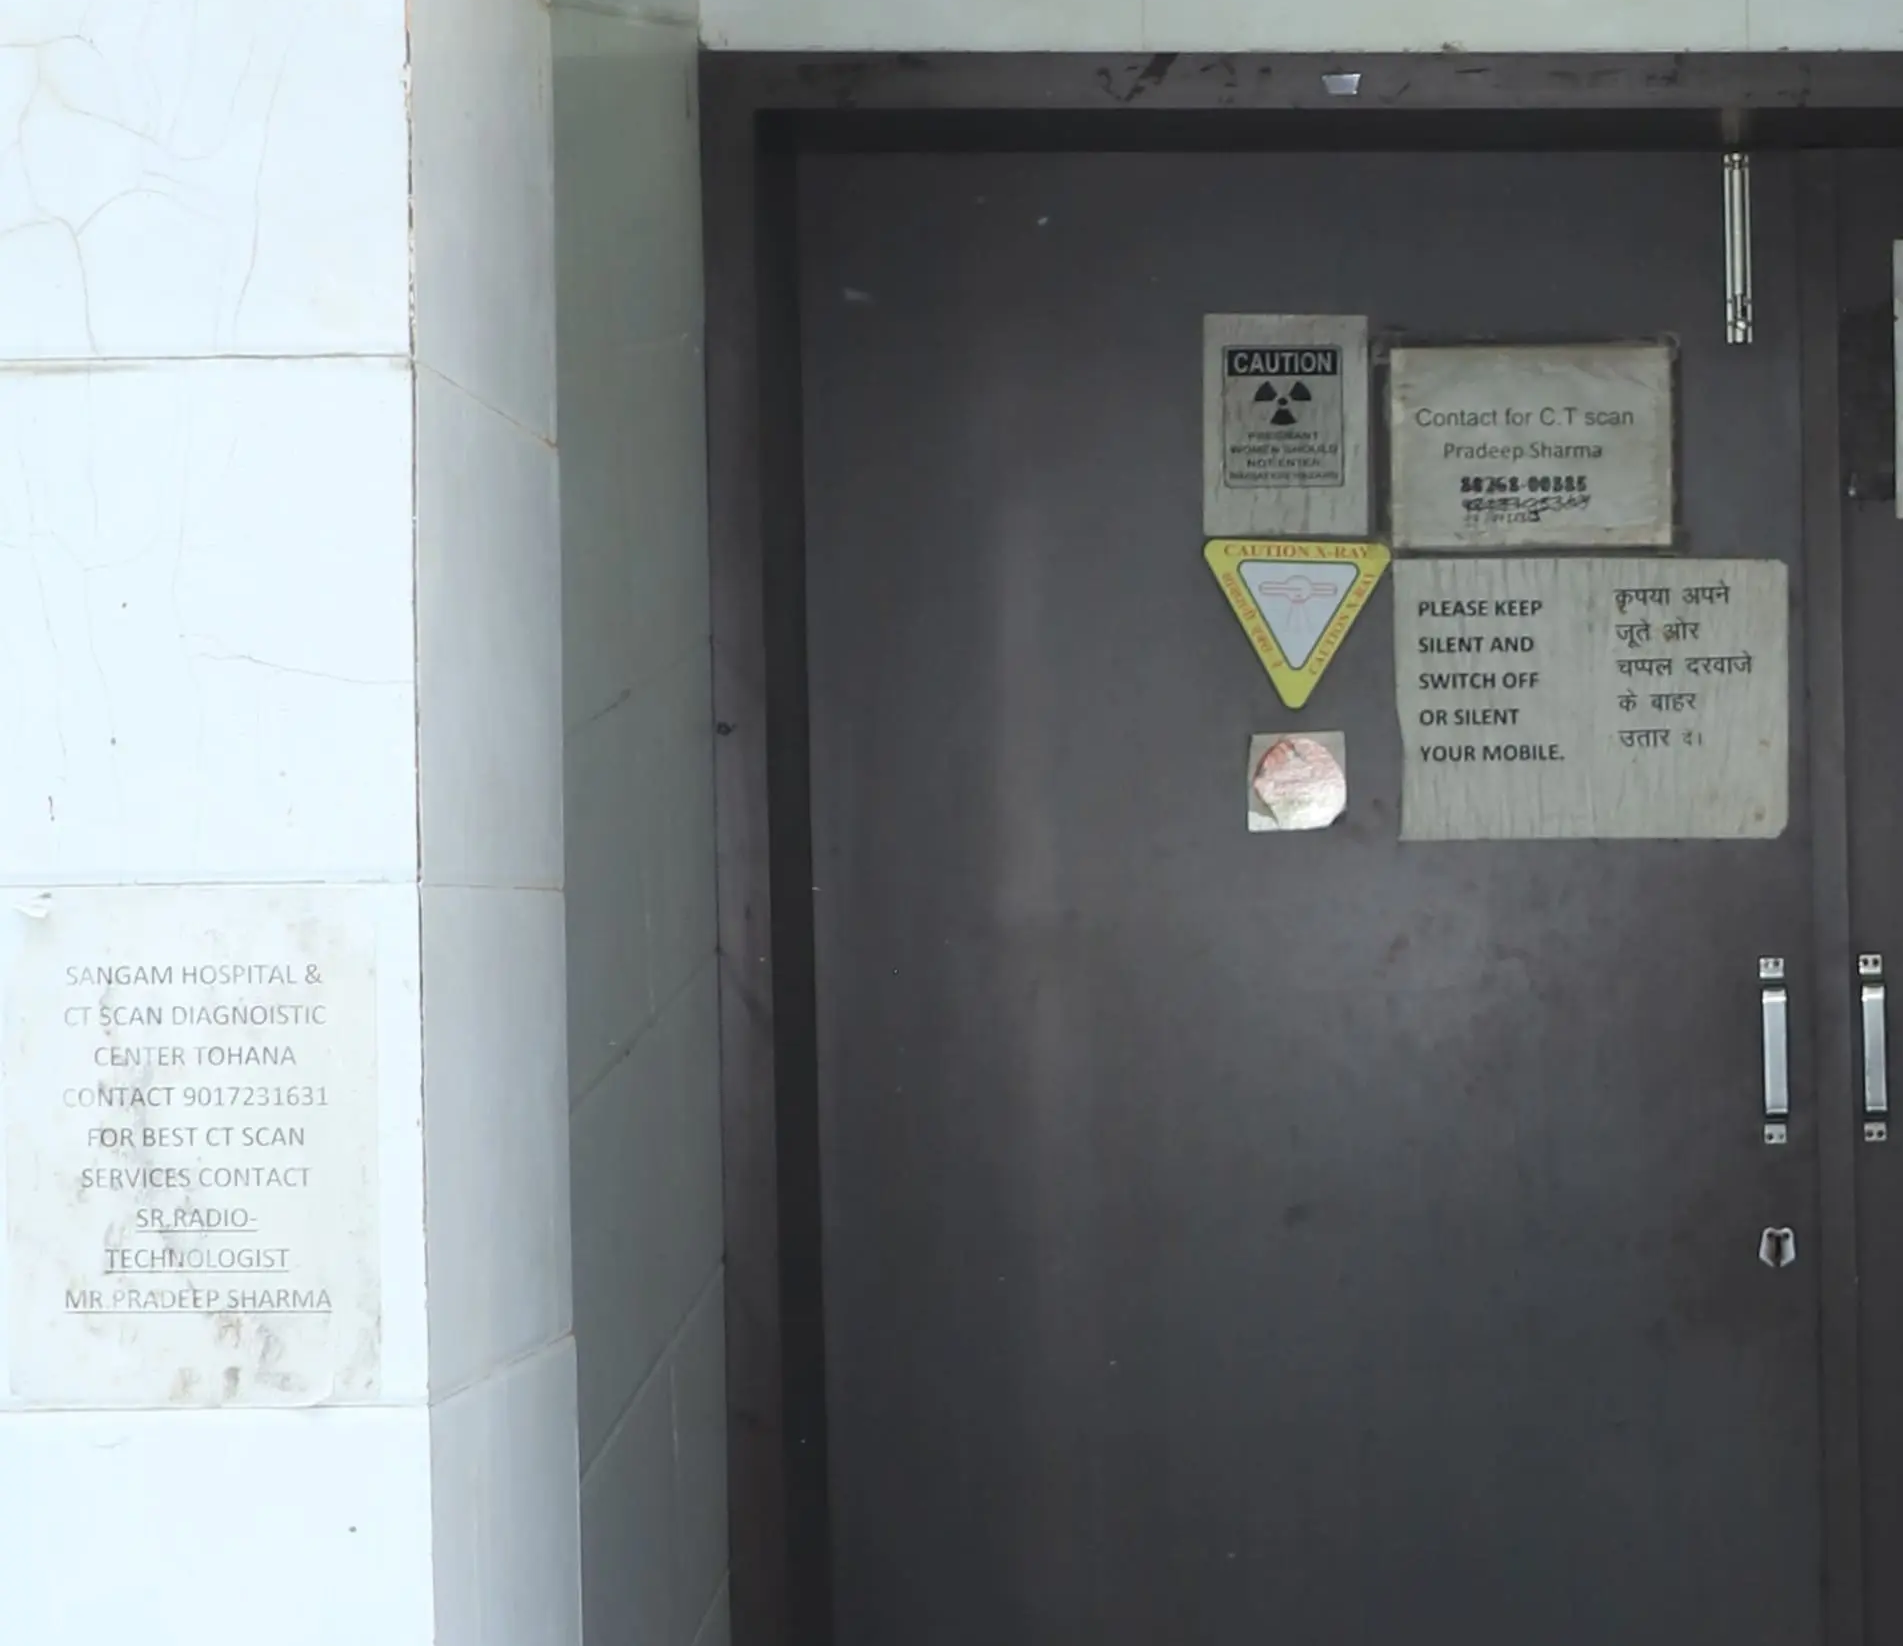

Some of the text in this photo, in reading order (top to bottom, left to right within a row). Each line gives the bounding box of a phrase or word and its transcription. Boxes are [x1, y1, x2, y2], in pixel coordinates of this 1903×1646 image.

[1234, 351, 1332, 373] CAUTION
[1415, 407, 1634, 427] Contact for C.T scan
[1444, 442, 1603, 462] Pradeep Sharma
[1224, 544, 1370, 560] CAUTION X-RAY
[1614, 579, 1731, 614] कृपया अपने
[1418, 600, 1543, 617] PLEASE KEEP
[1615, 618, 1652, 649] जूते
[1418, 637, 1534, 653] SILENT AND
[1616, 649, 1754, 676] चप्पल दरवाजे
[1419, 672, 1540, 690] SWITCH OFF
[1617, 687, 1638, 712] के
[1419, 709, 1520, 726] OR SILENT
[1617, 728, 1671, 747] उतार
[1420, 744, 1566, 762] YOUR MOBILE.
[66, 964, 323, 986] SANGAM HOSPITAL &
[63, 1006, 91, 1027] CT
[99, 1005, 163, 1027] SCAN
[94, 1045, 297, 1067] CENTER TOHANA
[62, 1086, 329, 1109] CONTACT 9017231631
[87, 1126, 305, 1148] FOR BEST CT SCAN
[80, 1167, 311, 1189] SERVICES CONTACT
[105, 1248, 290, 1270] TECHNOLOGIST
[227, 1288, 333, 1311] SHARMA
